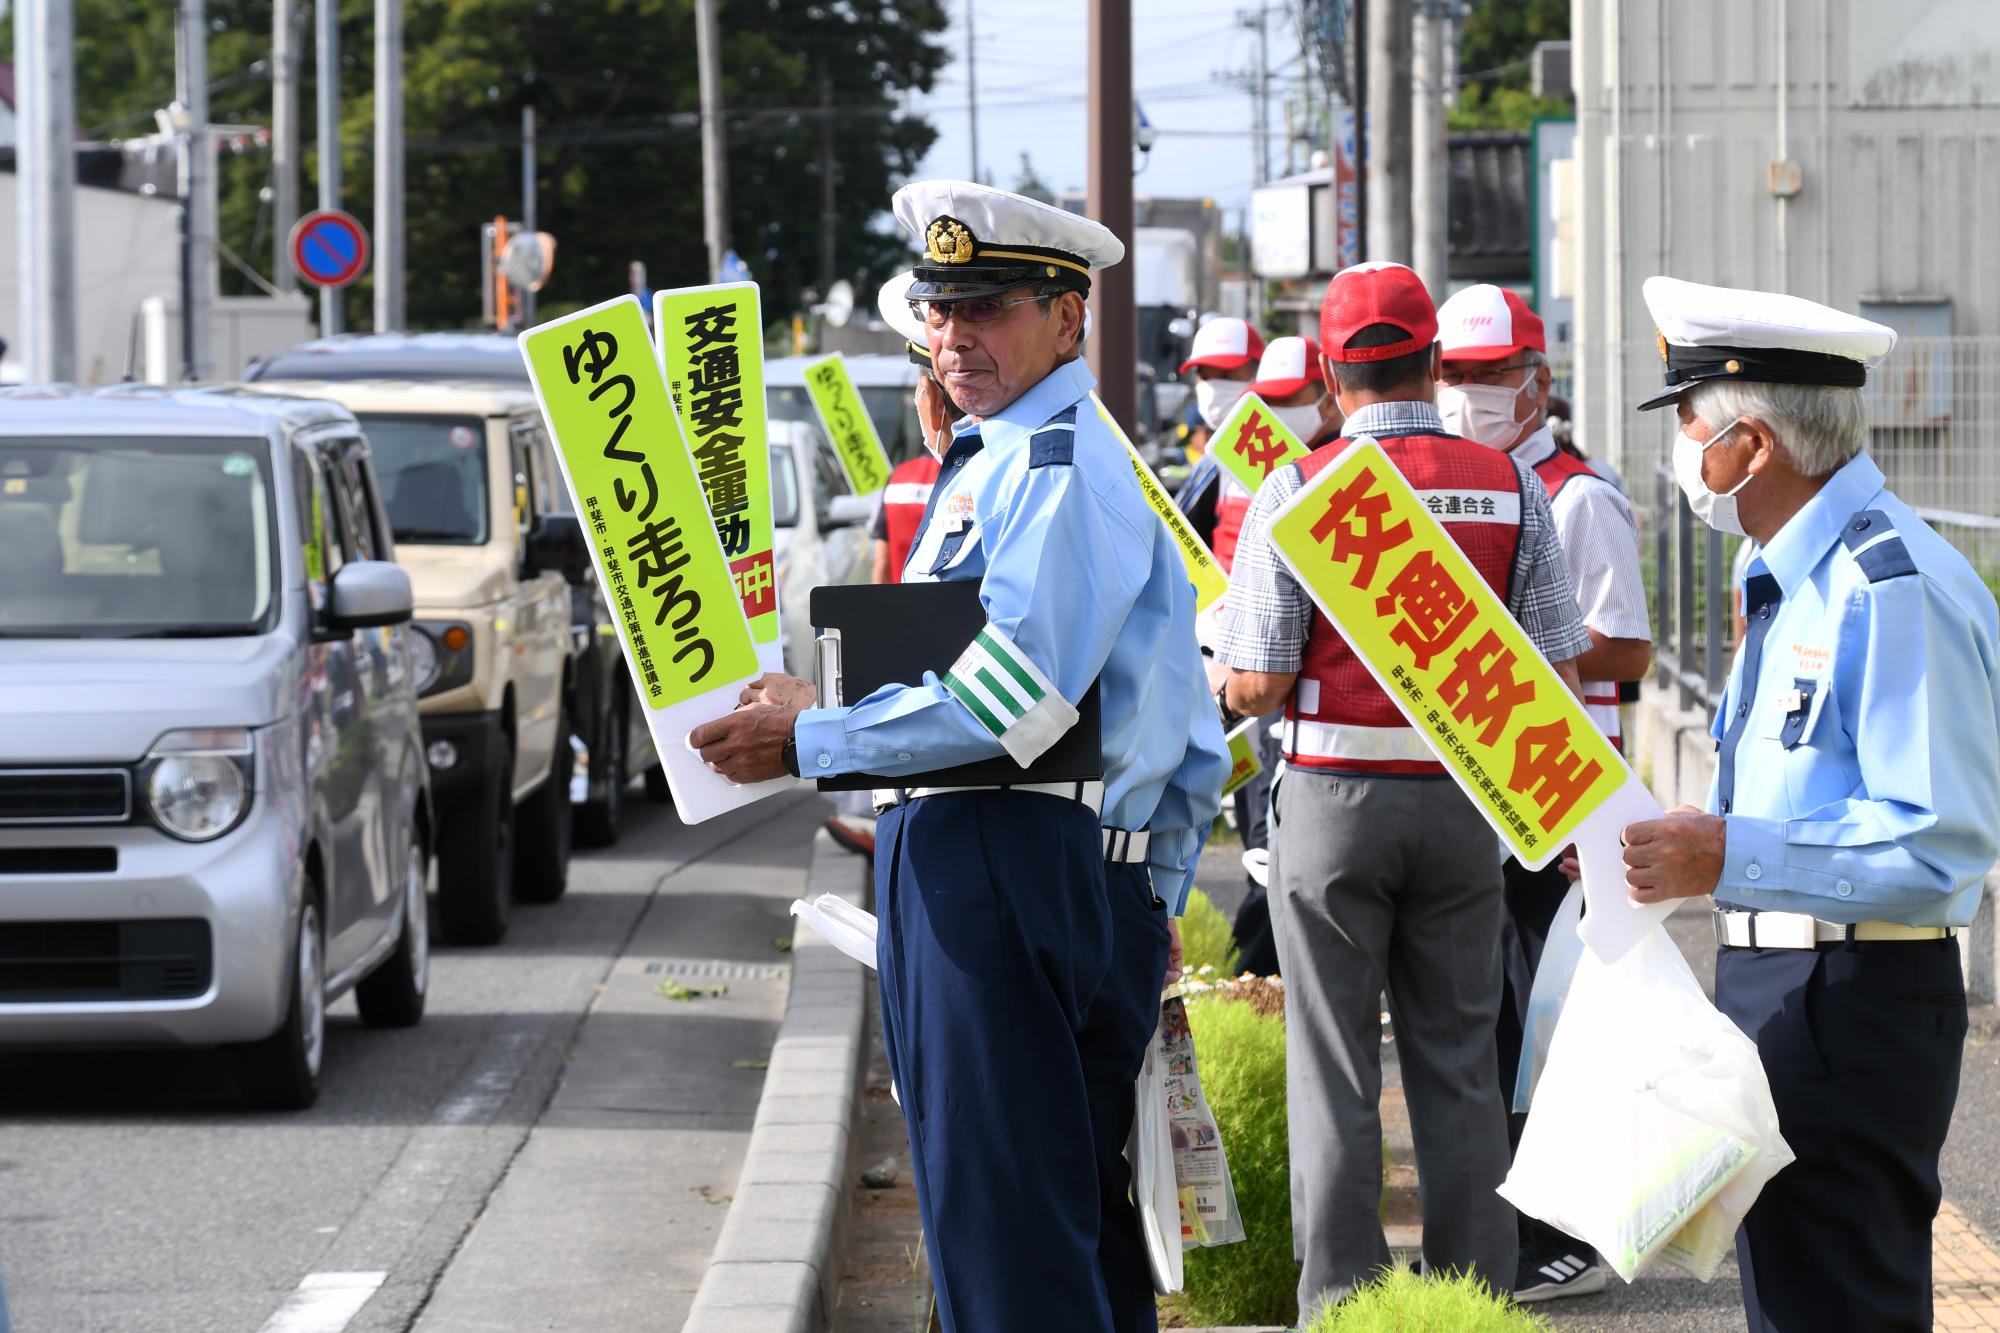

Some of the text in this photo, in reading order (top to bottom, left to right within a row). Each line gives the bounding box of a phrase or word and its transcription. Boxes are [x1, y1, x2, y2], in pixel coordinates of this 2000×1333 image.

[562, 329, 715, 683] ゆっくり走ろう
[1310, 466, 1604, 834] 交通安全
